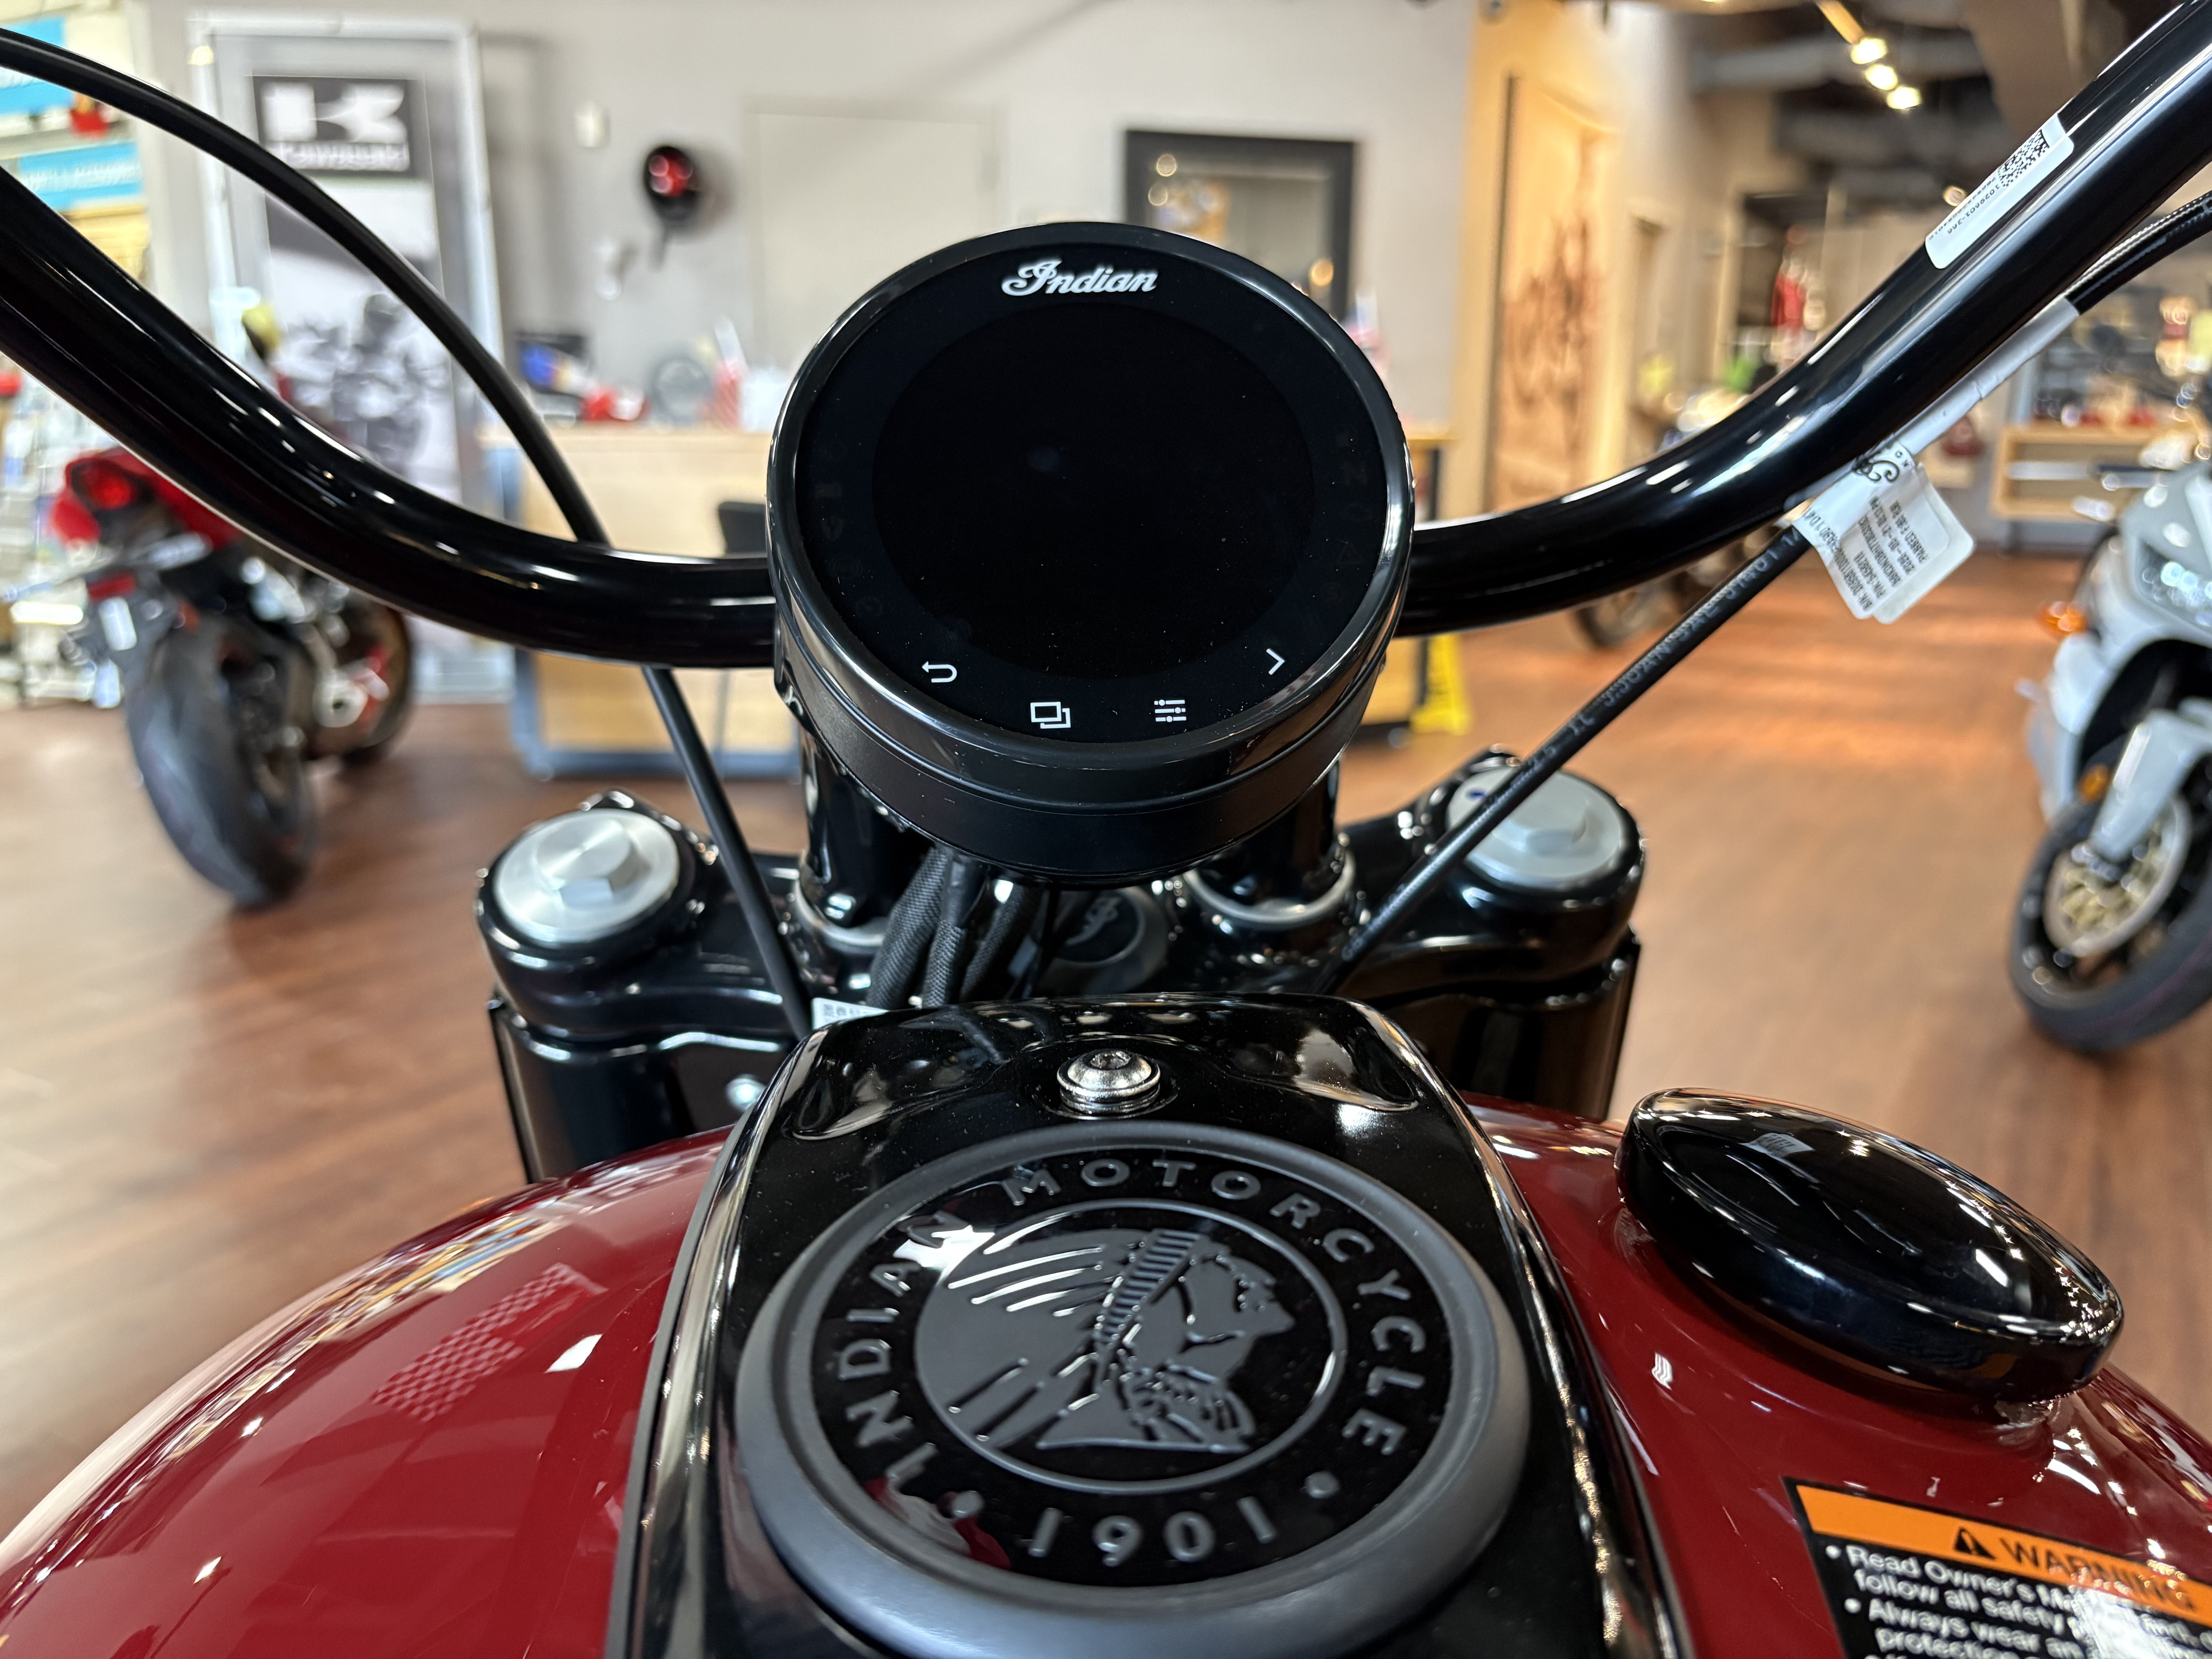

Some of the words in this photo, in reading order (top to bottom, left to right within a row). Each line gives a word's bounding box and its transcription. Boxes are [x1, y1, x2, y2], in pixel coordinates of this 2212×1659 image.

[1001, 258, 1159, 296] Indian
[838, 1207, 974, 1489] INDIAN
[1001, 1158, 1427, 1456] MOTORCYCLE
[1027, 1495, 1278, 1568] 1901
[1845, 1545, 1922, 1579] Read
[1854, 1568, 1939, 1606] follow
[1944, 1589, 1980, 1613] all
